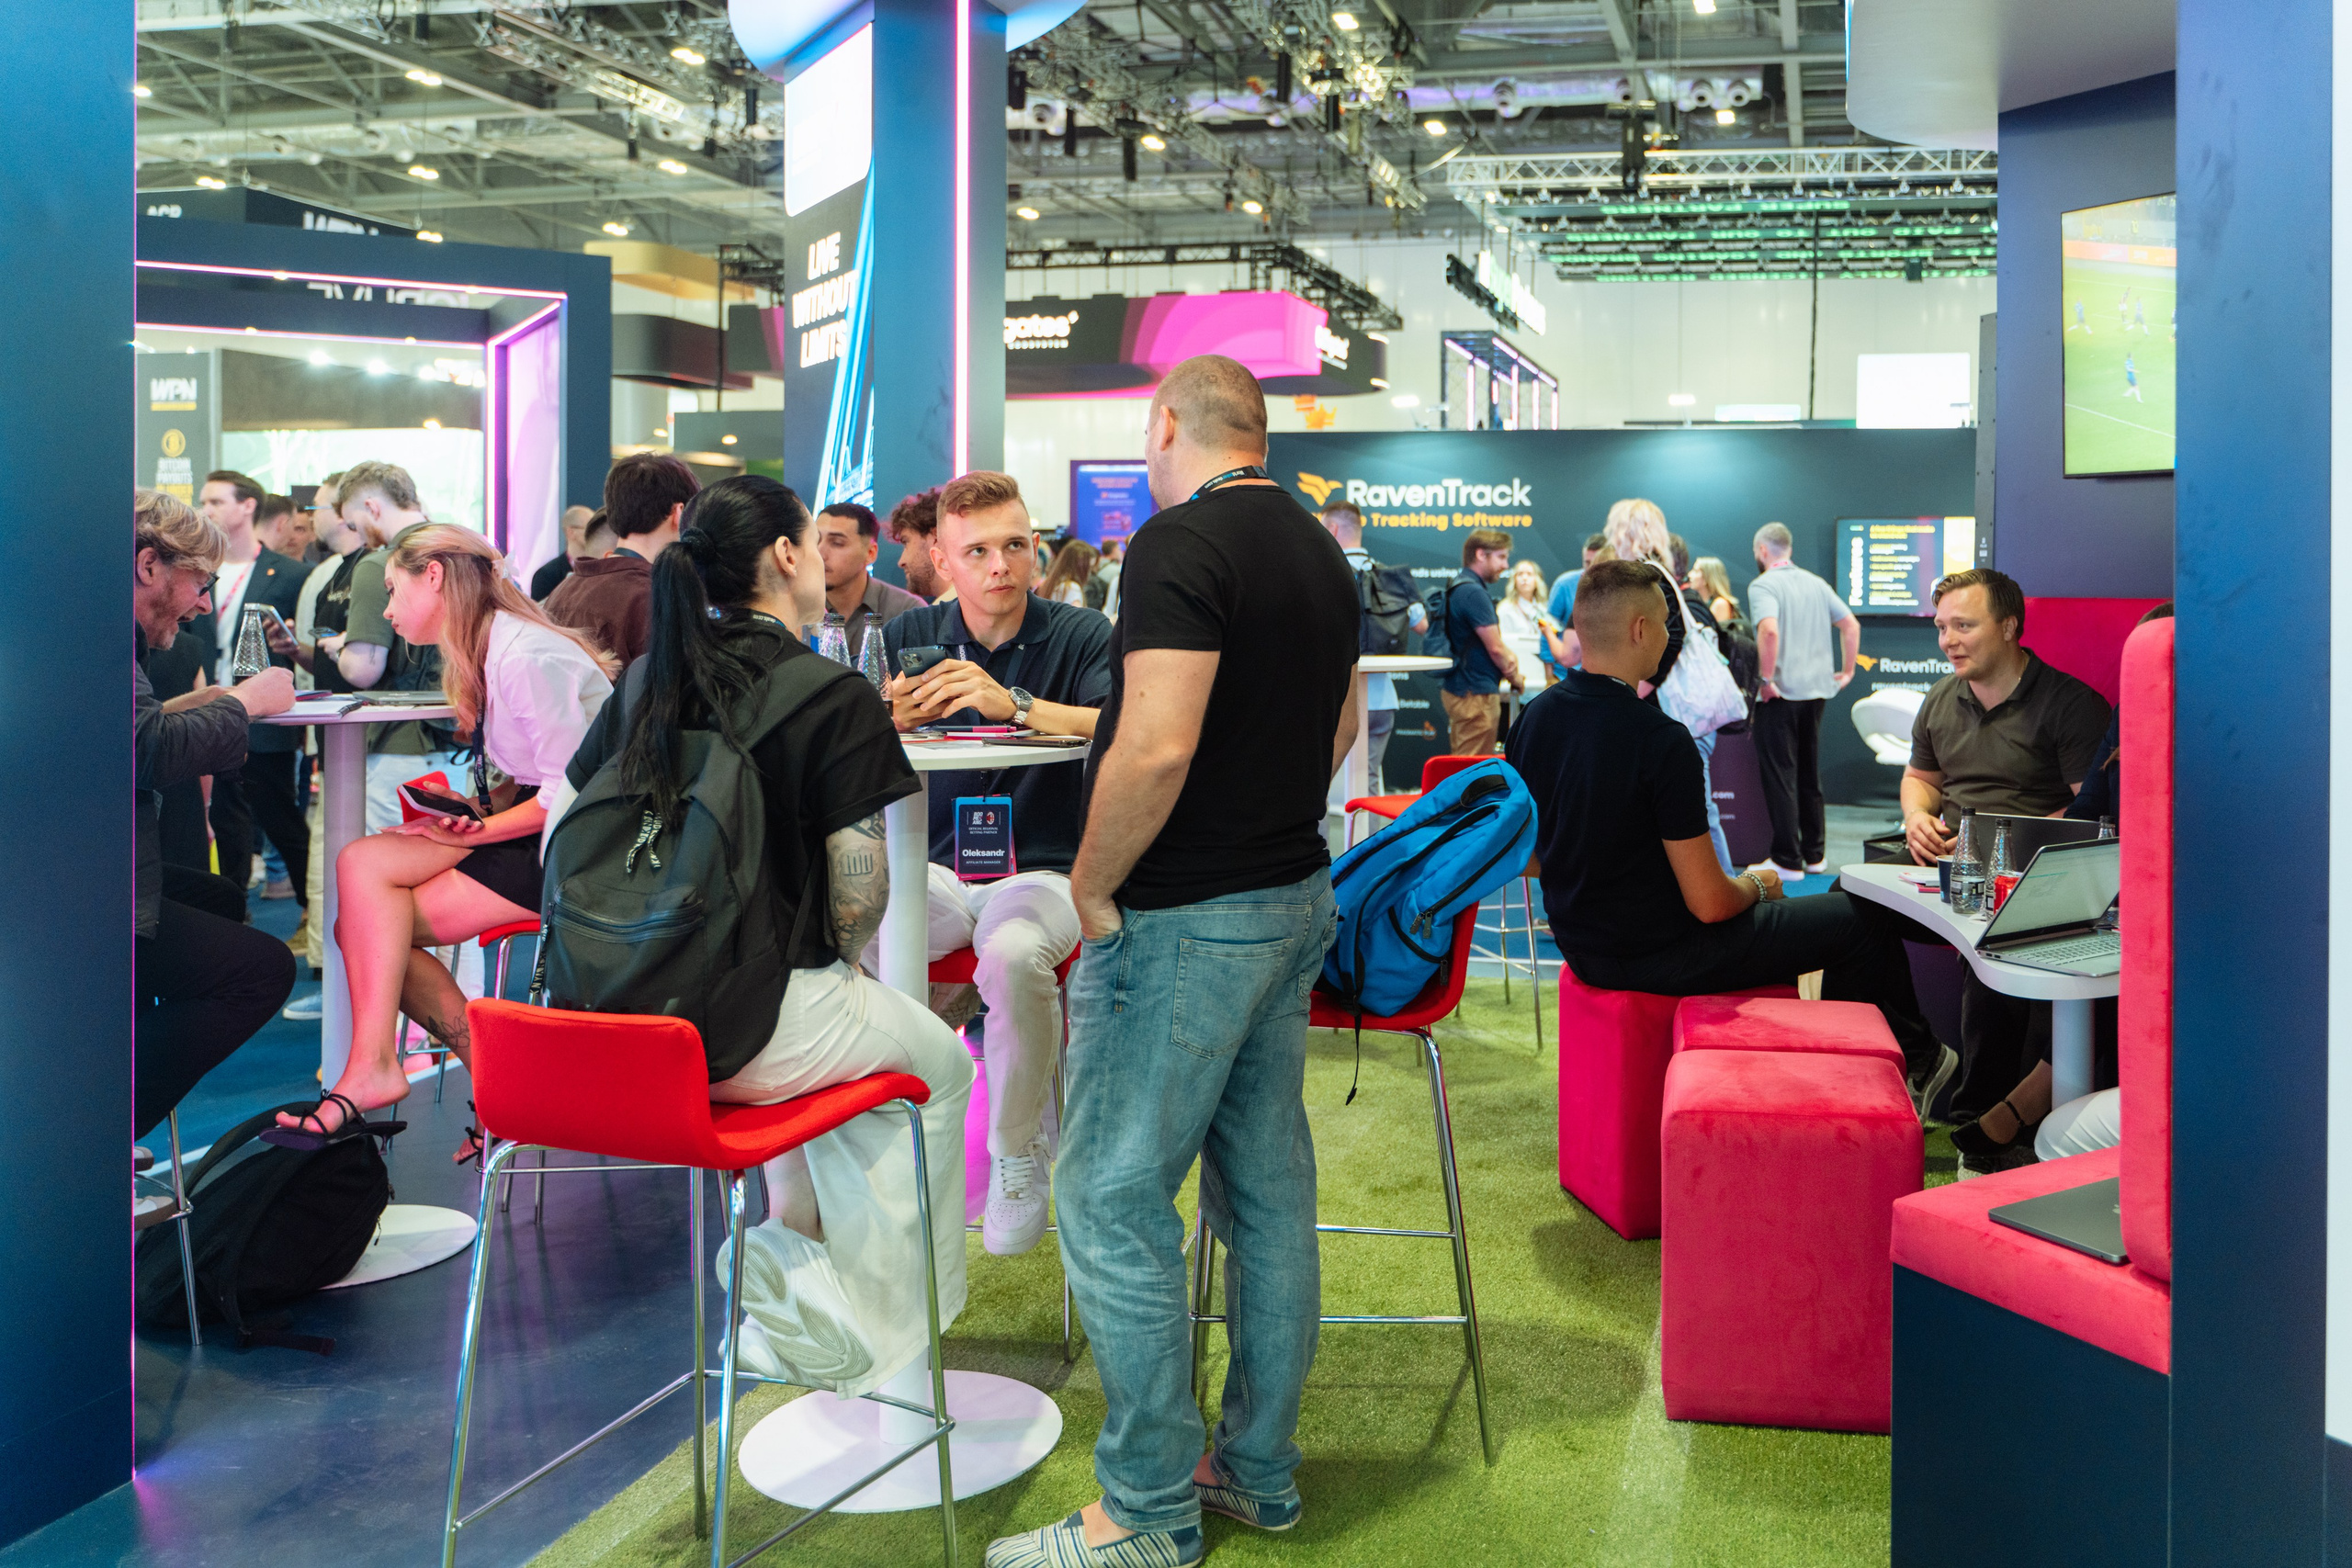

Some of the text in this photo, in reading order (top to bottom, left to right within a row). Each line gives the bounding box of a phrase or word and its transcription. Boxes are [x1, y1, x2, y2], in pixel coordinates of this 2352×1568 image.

[808, 231, 842, 280] LIVE
[792, 269, 859, 329] WITHOUT
[800, 319, 848, 368] LIMITS
[150, 378, 198, 401] WPN
[1346, 478, 1532, 507] RavenTrack
[1371, 512, 1449, 532] Tracking
[1452, 512, 1532, 528] Software
[1880, 658, 1955, 674] RavenTra
[962, 849, 1005, 857] Oleksandr
